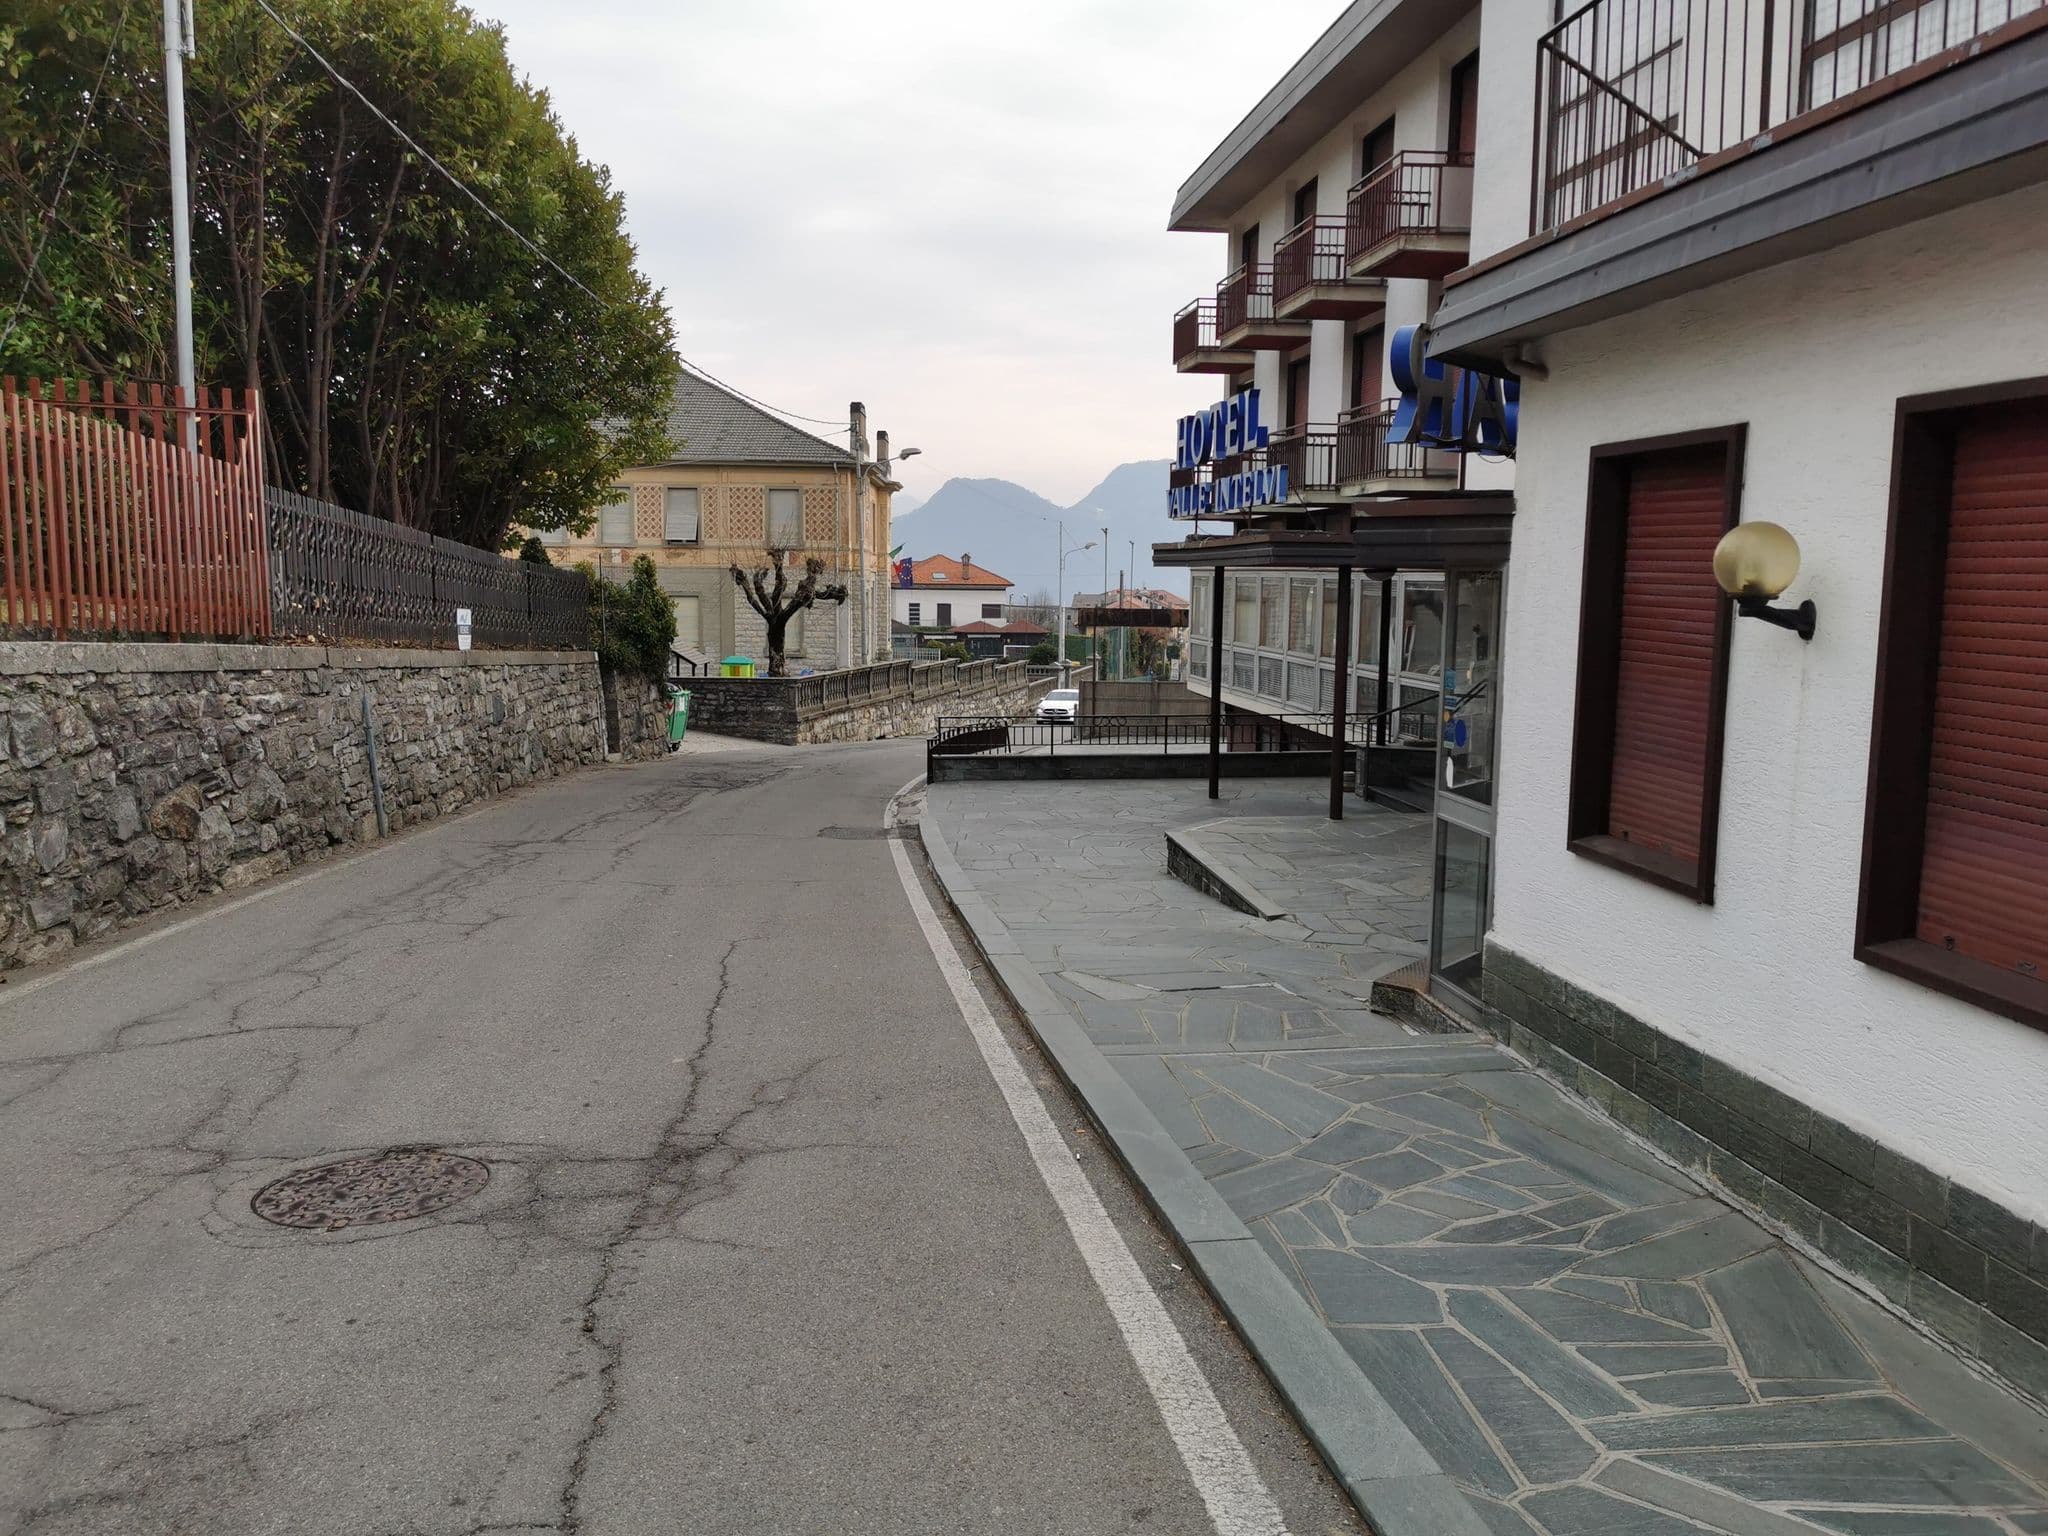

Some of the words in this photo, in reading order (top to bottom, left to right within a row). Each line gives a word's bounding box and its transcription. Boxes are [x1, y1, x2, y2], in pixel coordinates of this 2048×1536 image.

[1176, 389, 1268, 469] HOTEL
[1166, 483, 1213, 518] VALLE
[1215, 464, 1288, 512] INTELVI
